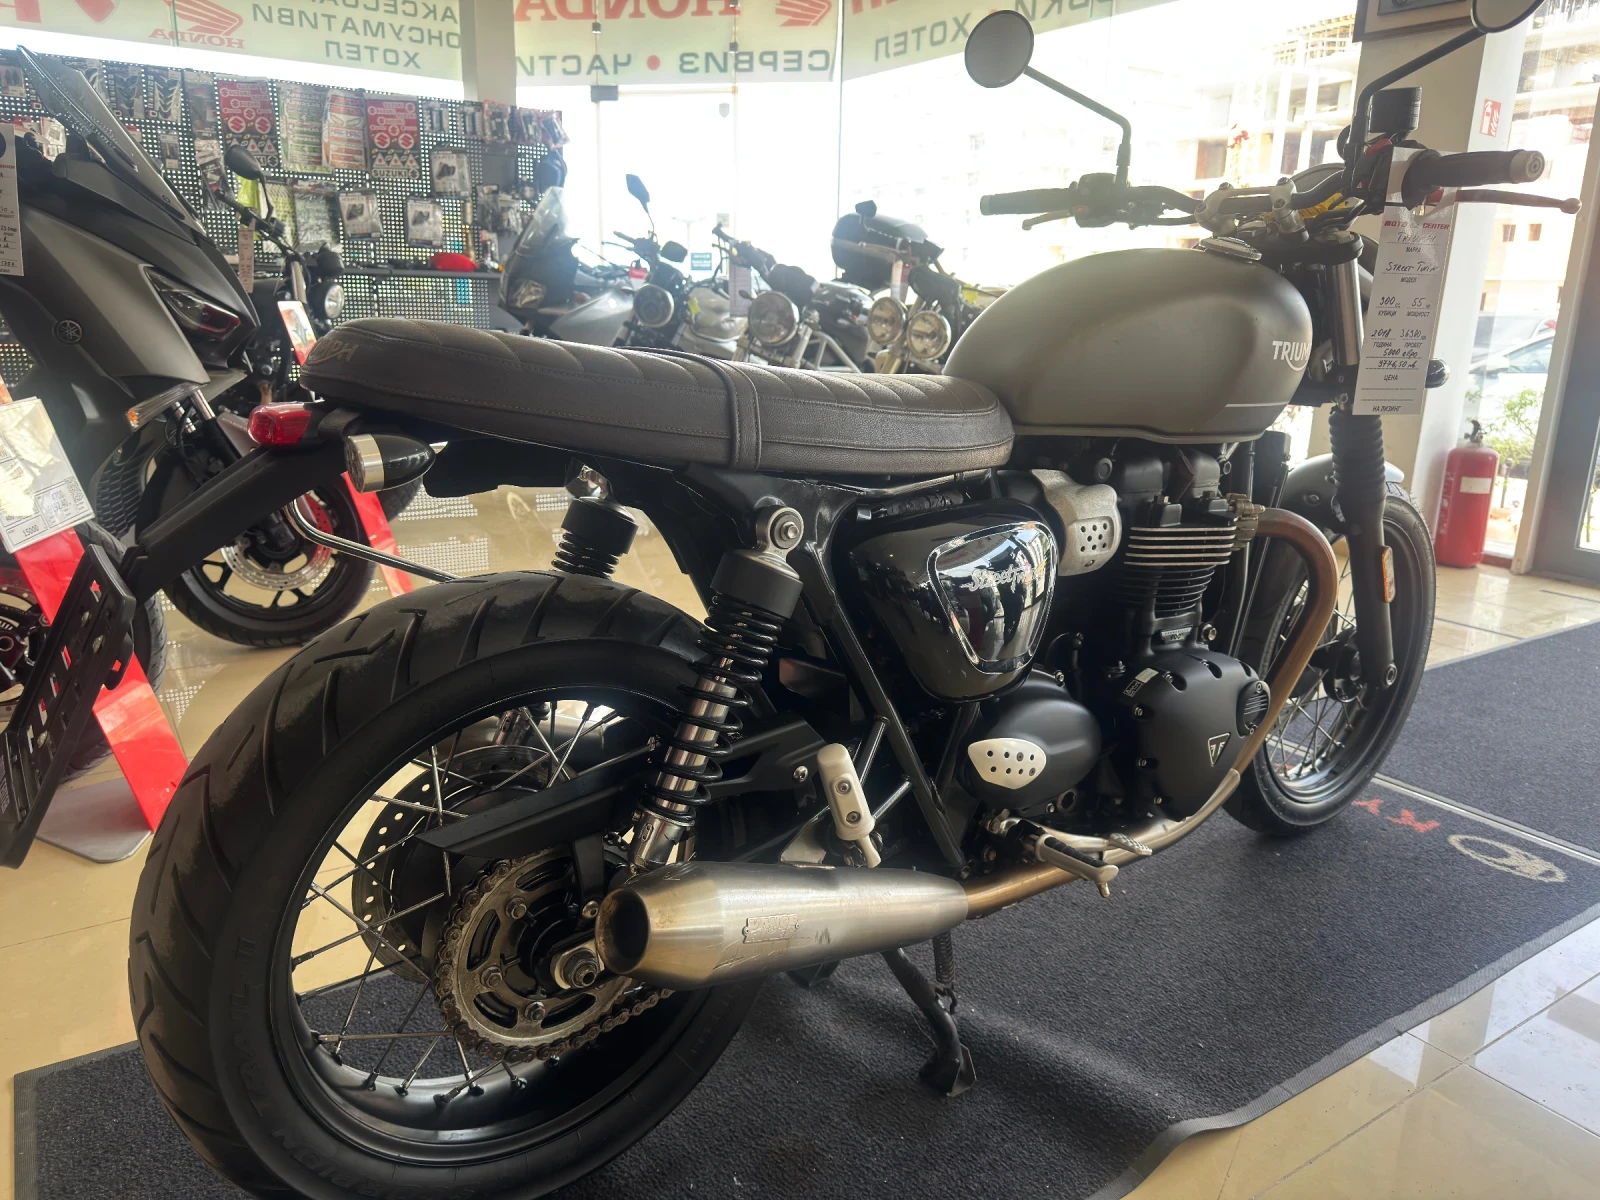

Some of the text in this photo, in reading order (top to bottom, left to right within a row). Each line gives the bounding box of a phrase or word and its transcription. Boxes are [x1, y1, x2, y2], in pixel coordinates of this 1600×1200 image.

[372, 169, 408, 178] SUZUKI
[1422, 222, 1450, 230] CENTER
[1411, 297, 1426, 308] 55
[1371, 328, 1392, 338] 2018
[1383, 348, 1401, 357] 5000
[1383, 374, 1399, 382] ЦЕНА
[22, 524, 39, 538] 15000
